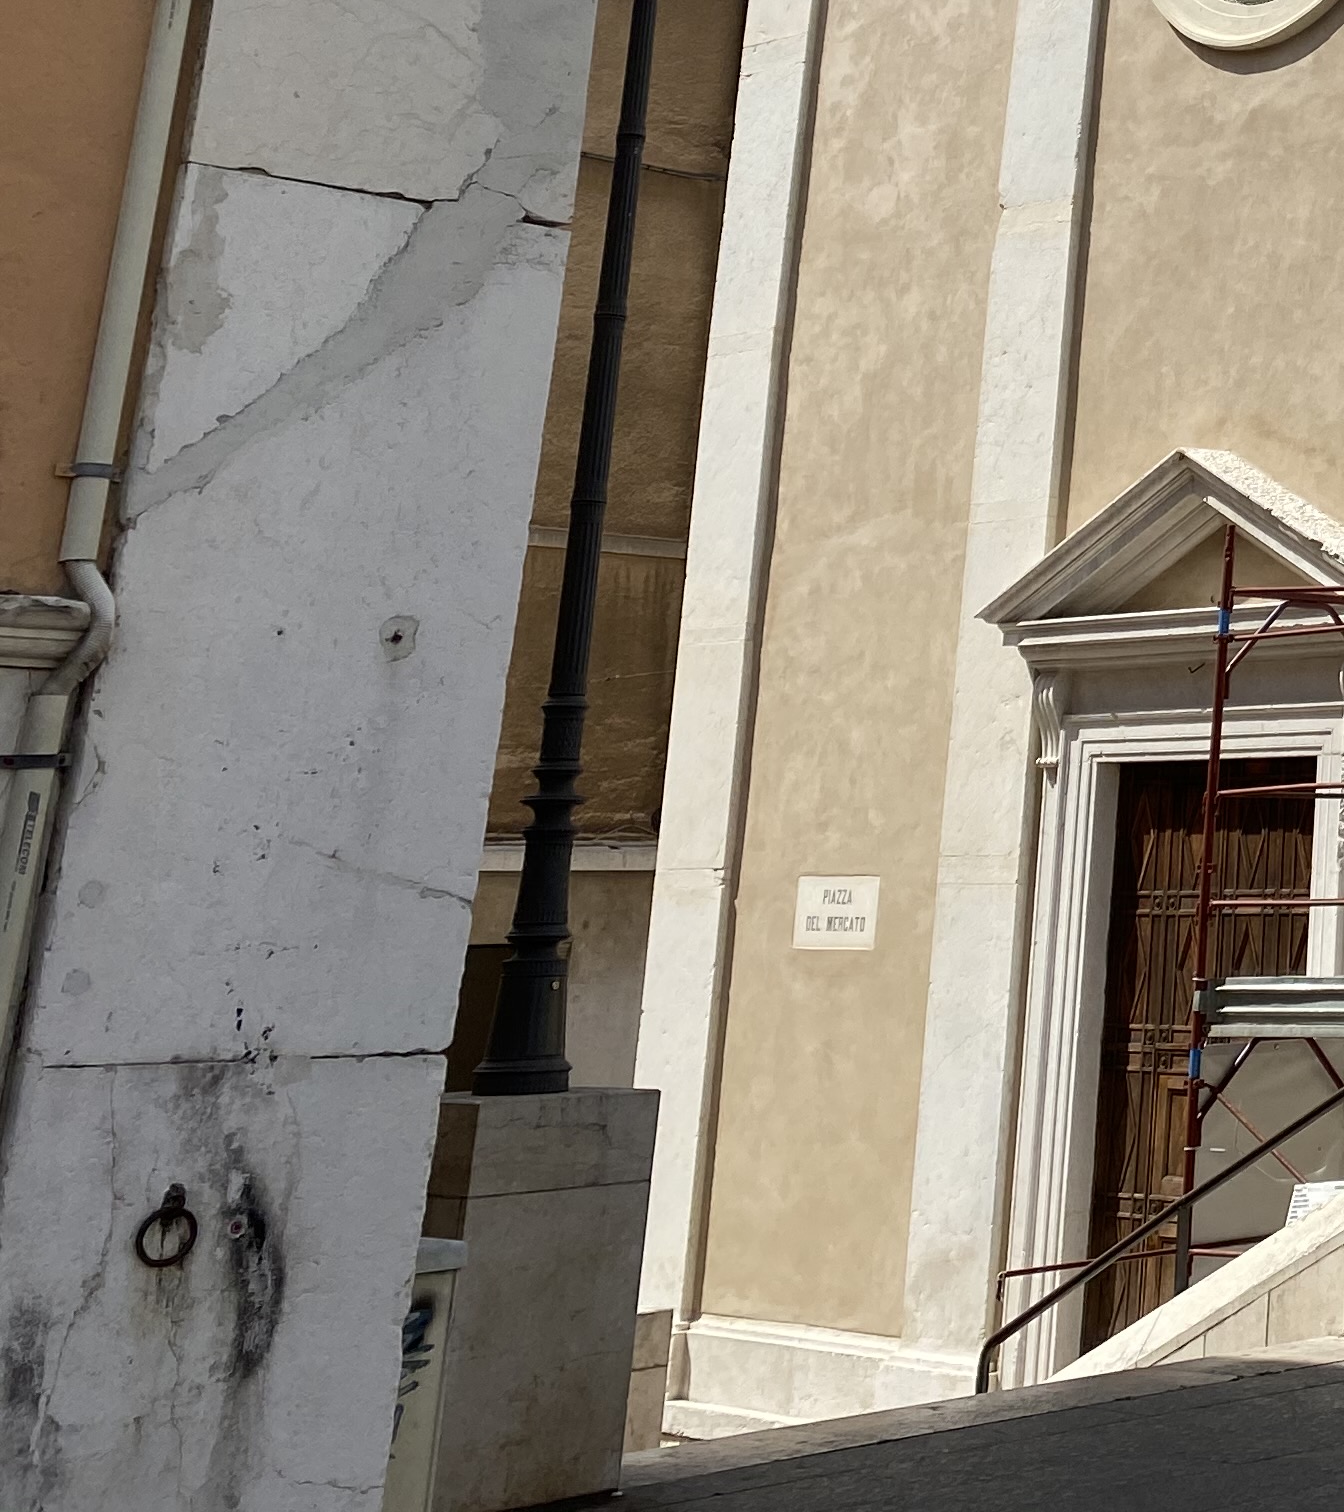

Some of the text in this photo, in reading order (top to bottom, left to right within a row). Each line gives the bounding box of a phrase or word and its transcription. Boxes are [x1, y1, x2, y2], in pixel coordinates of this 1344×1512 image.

[822, 889, 853, 905] PIAZZA
[805, 916, 866, 932] DEL MERCATO
